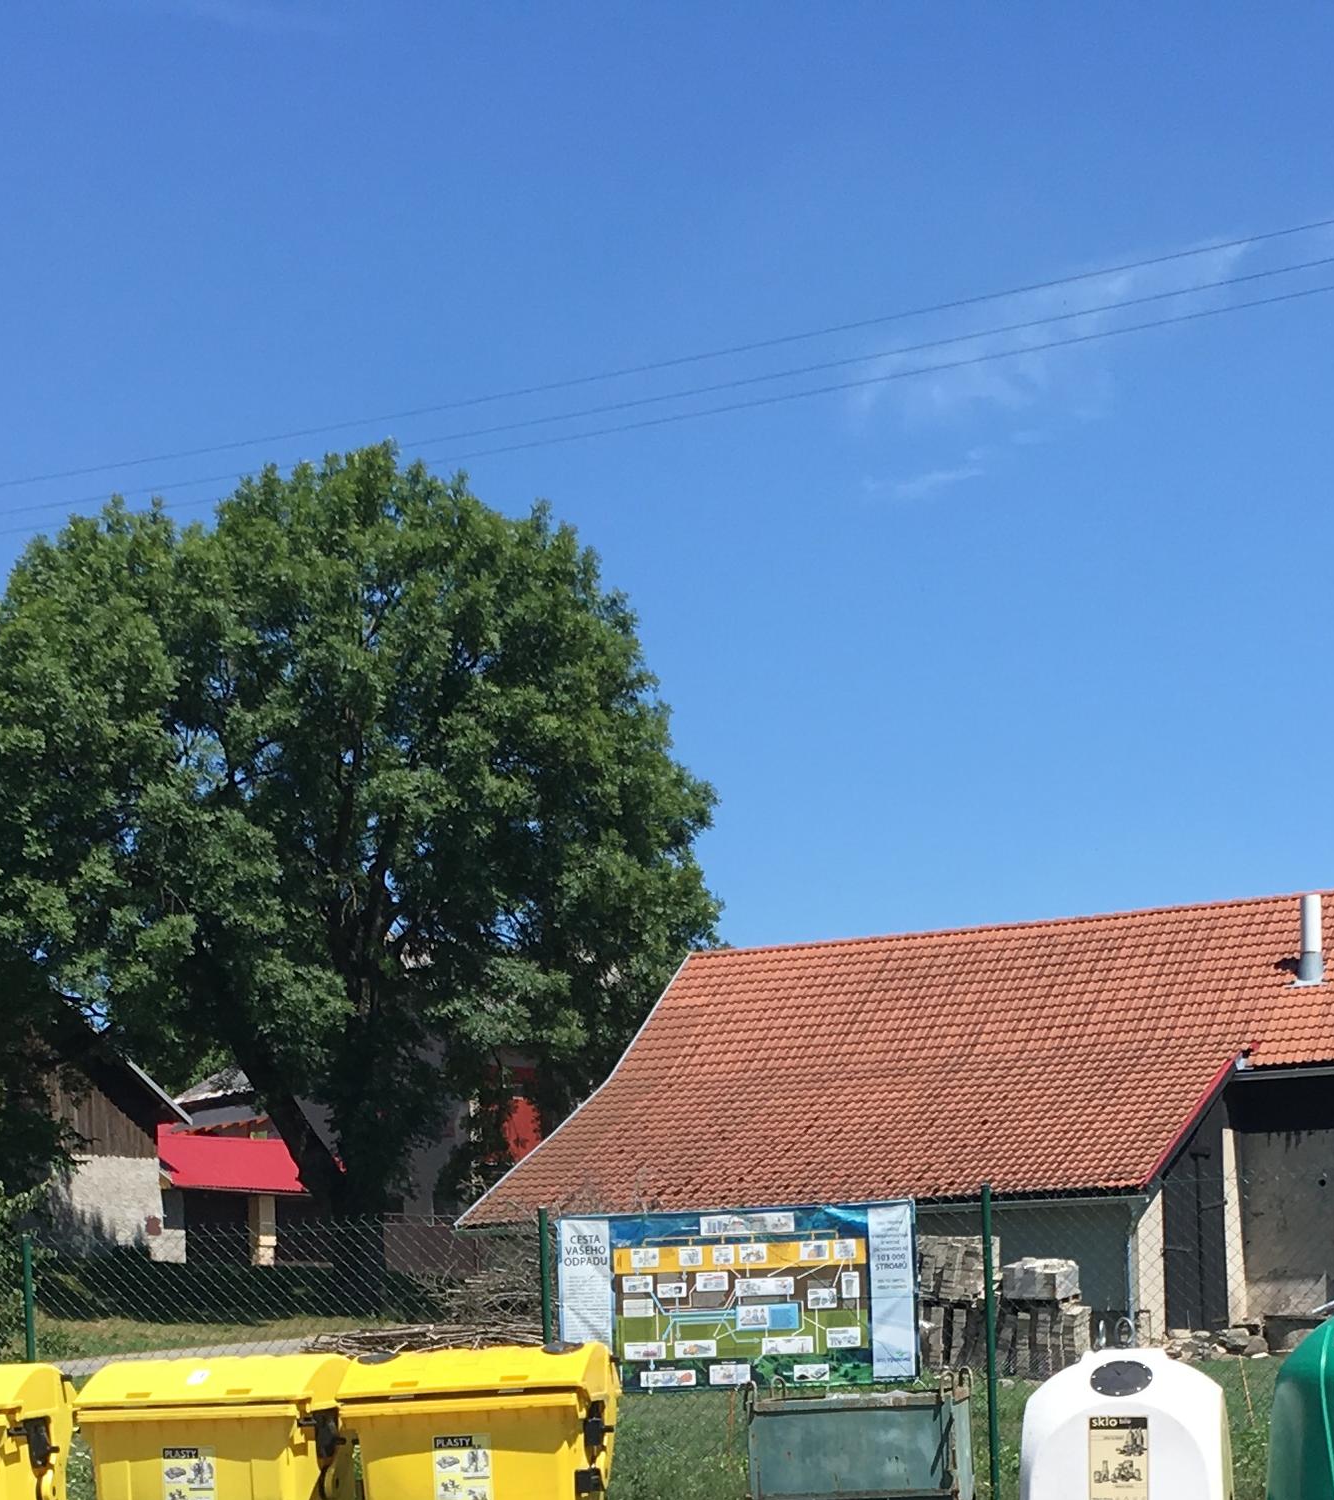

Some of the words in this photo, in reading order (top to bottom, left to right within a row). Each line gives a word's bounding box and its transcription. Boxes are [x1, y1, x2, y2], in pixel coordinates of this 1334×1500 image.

[570, 1234, 601, 1245] CESTA
[565, 1245, 606, 1256] VAŠEHO
[564, 1256, 608, 1267] ODPADU
[1091, 1416, 1118, 1427] sklo
[436, 1438, 471, 1447] PLASTY
[164, 1449, 197, 1459] PLASTY
